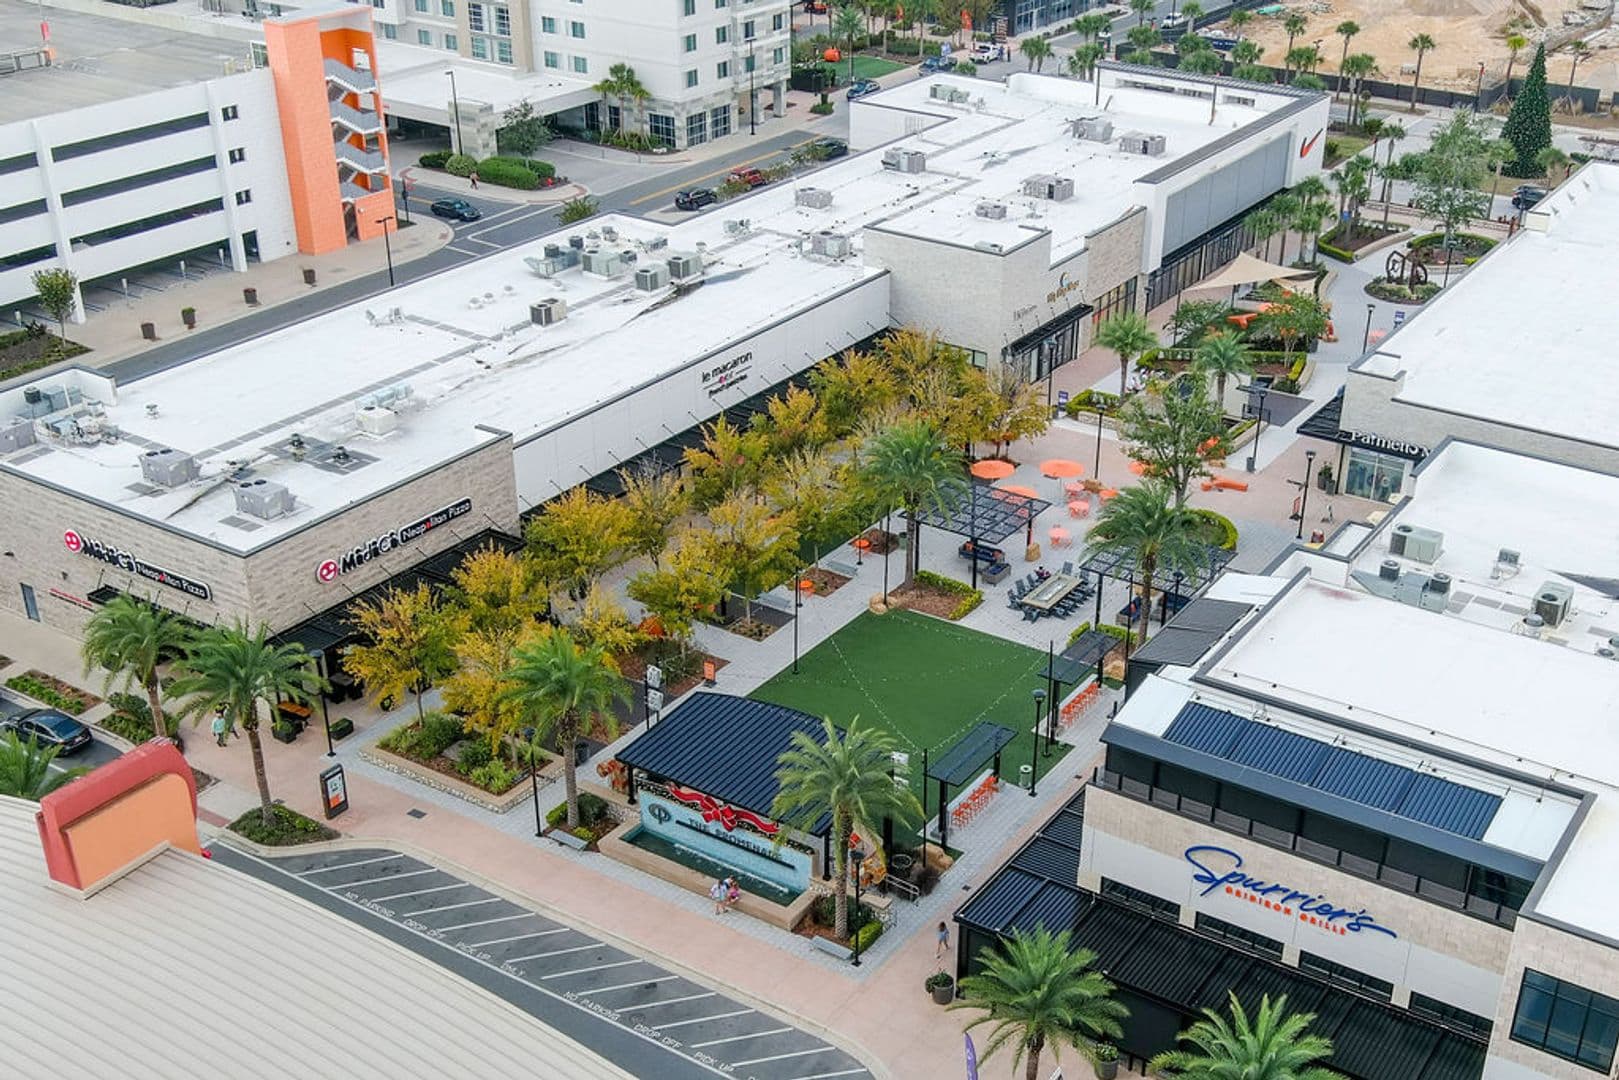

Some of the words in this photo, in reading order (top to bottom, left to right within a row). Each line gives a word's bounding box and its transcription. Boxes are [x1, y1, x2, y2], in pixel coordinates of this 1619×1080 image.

[702, 371, 711, 384] le
[711, 351, 753, 378] macaron
[448, 501, 470, 518] Pizza
[180, 579, 206, 598] Pizza
[1184, 846, 1398, 939] Spurrier's
[1225, 885, 1293, 916] GRIDIRON
[1299, 912, 1347, 936] GRILLE
[562, 990, 579, 1002] NO
[580, 998, 621, 1022] PARKING
[633, 1022, 661, 1038] DROP
[661, 1036, 684, 1049] OFF
[694, 1051, 718, 1067] PICK
